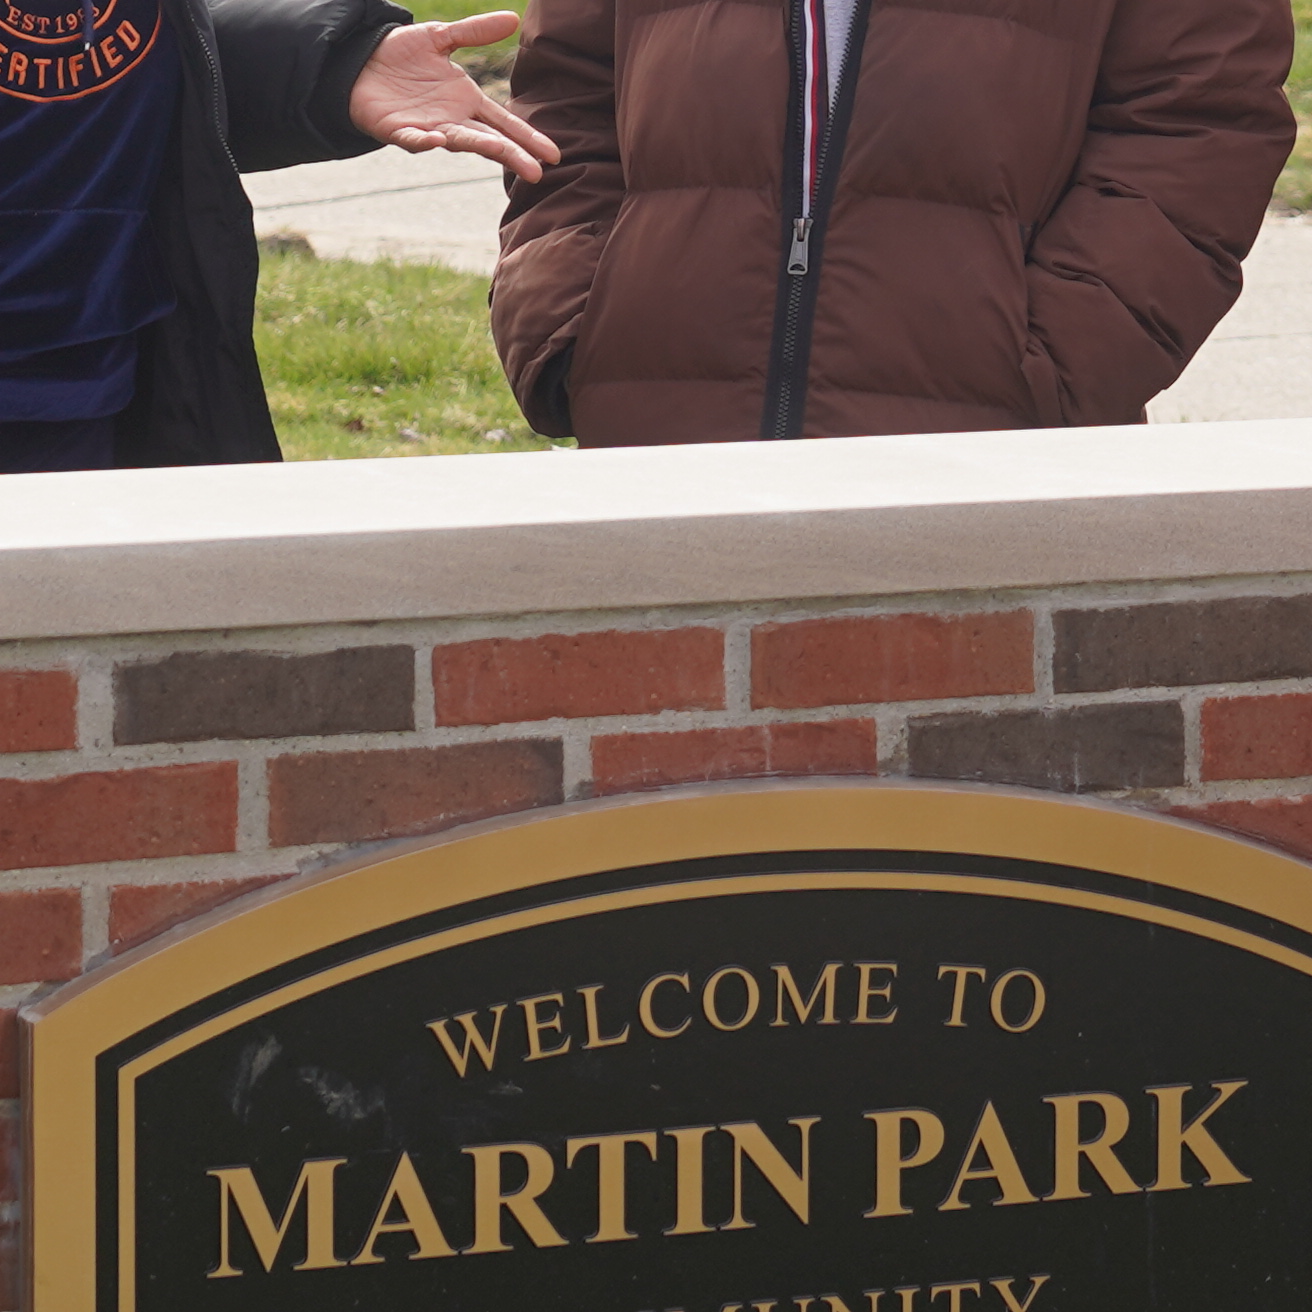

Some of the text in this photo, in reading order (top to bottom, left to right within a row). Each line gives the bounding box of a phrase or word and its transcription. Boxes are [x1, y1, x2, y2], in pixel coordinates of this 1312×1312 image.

[6, 5, 51, 34] EST
[425, 962, 1047, 1078] WELCOME TO
[205, 1079, 1253, 1279] MARTIN PARK
